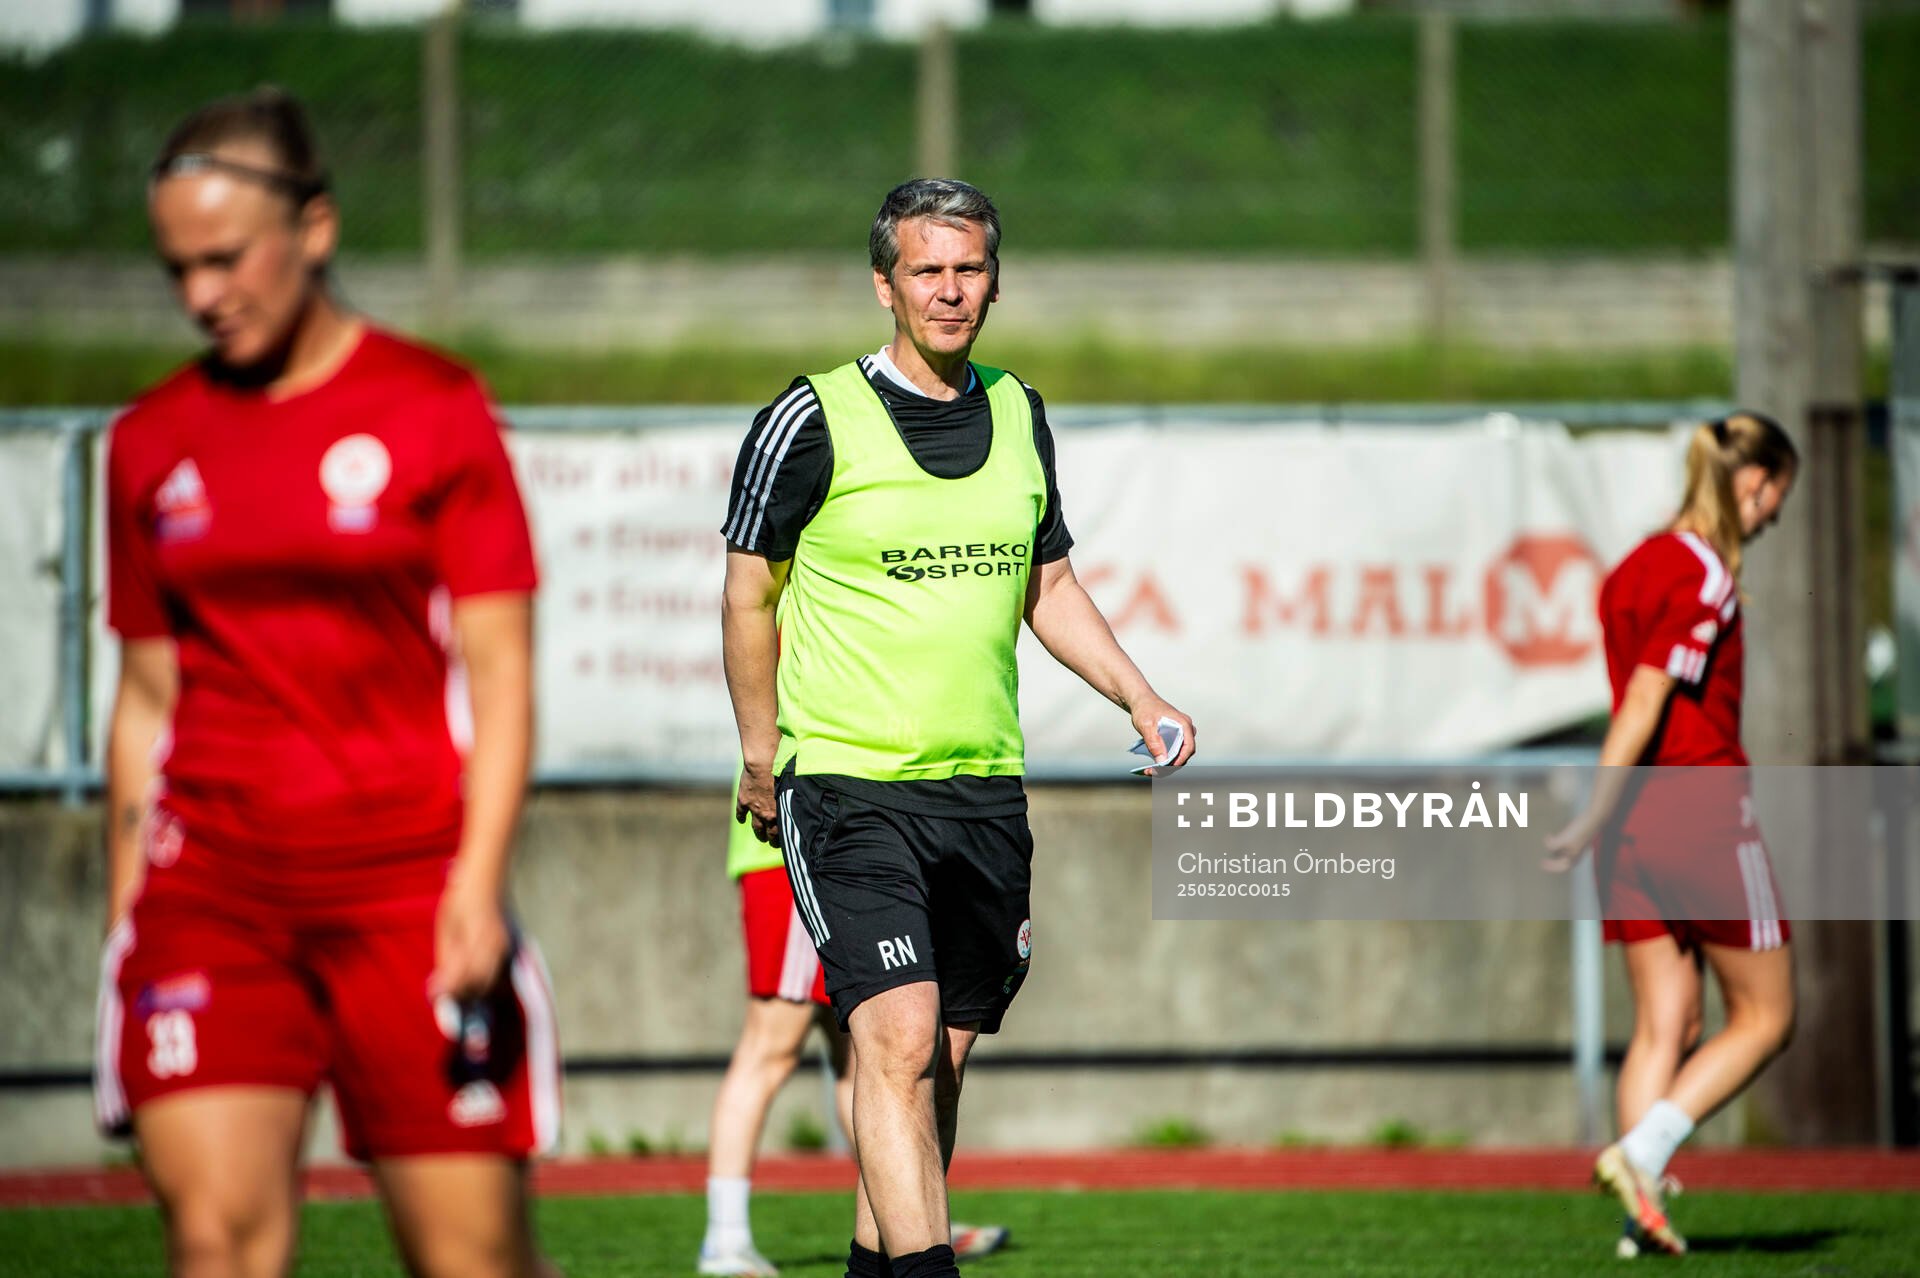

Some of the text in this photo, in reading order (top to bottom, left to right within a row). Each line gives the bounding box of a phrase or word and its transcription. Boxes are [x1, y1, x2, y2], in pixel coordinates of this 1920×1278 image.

[881, 543, 1027, 563] BAREKO
[927, 562, 1024, 579] SPORT
[877, 935, 918, 970] RN
